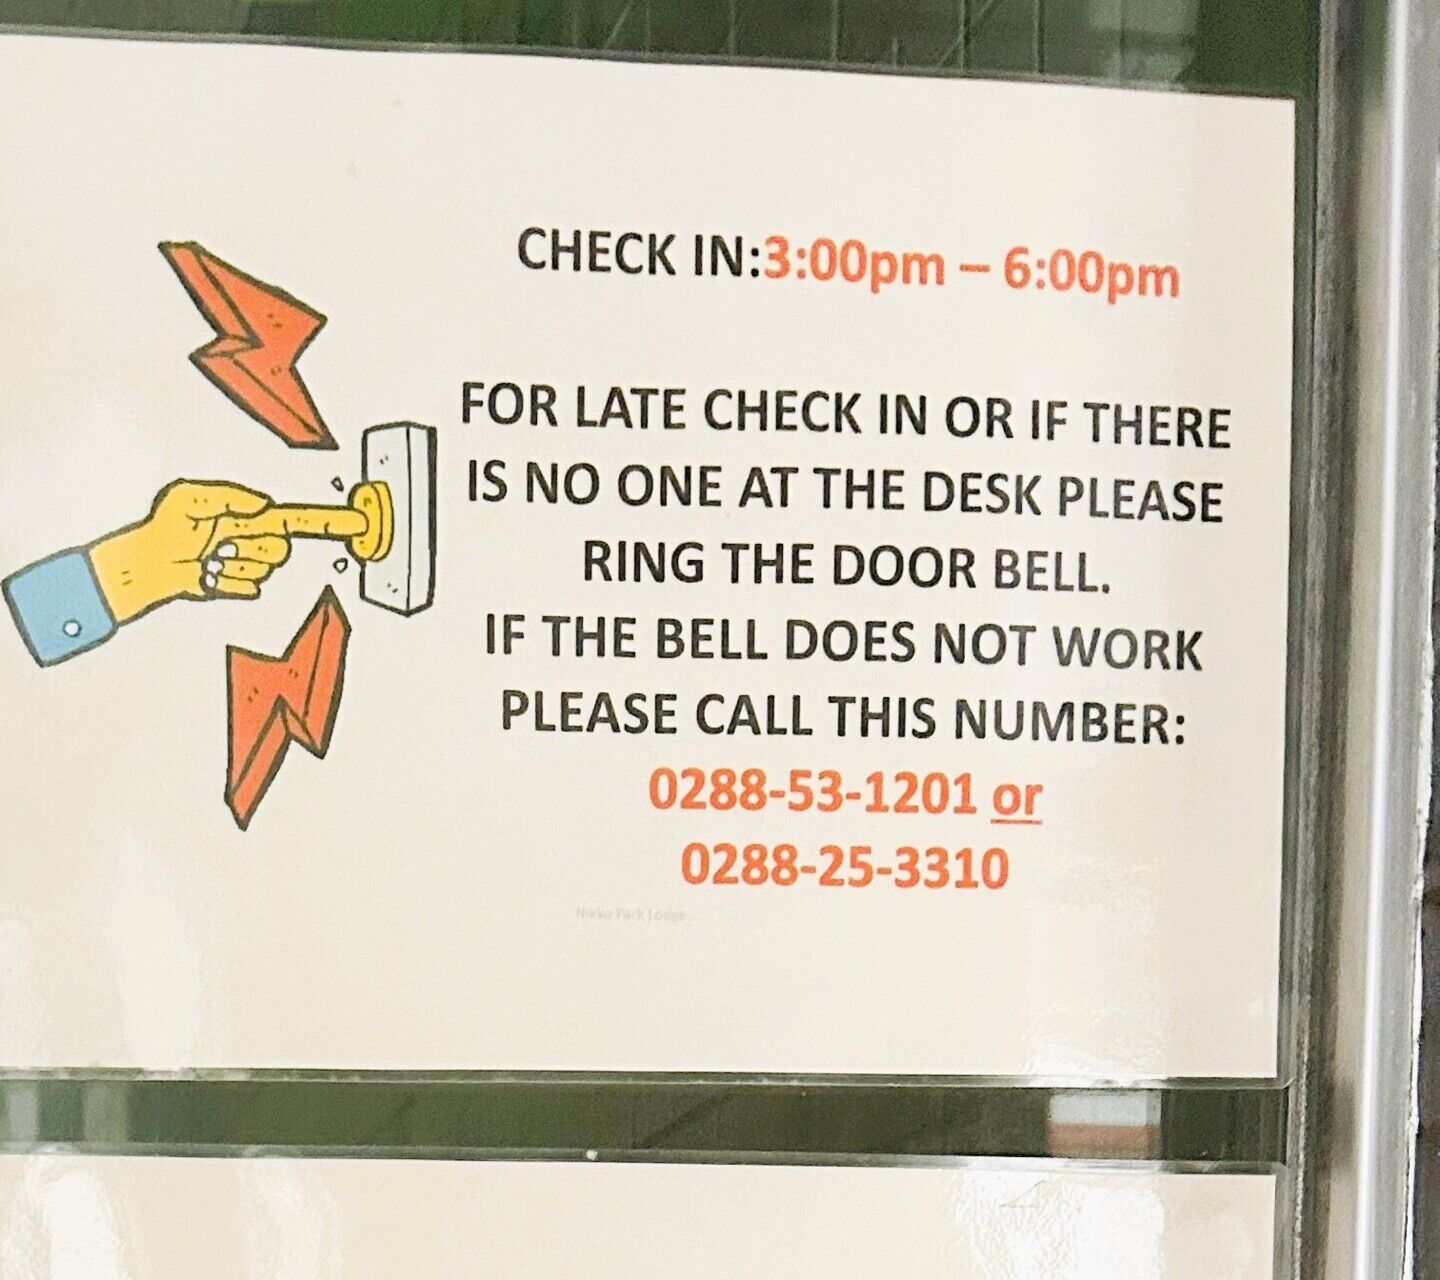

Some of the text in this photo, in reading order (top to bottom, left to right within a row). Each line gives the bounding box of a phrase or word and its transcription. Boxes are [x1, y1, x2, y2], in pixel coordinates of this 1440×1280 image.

[518, 227, 676, 275] CHECK
[1004, 246, 1179, 305] 6:00pm
[463, 382, 1231, 448] FOR LATE CHECK IN OR IF THERE
[469, 460, 1223, 523] IS NO ONE AT THE DESK PLEASE
[585, 540, 1110, 594] RING THE DOOR BELL.
[487, 614, 1203, 671] IF THE BELL DOES NOT WORK
[503, 690, 1185, 745] PLEASE CALL THIS NUMBER:
[649, 767, 1043, 825] 0288-53-1201 or
[682, 842, 1009, 890] 0288-25-3310
